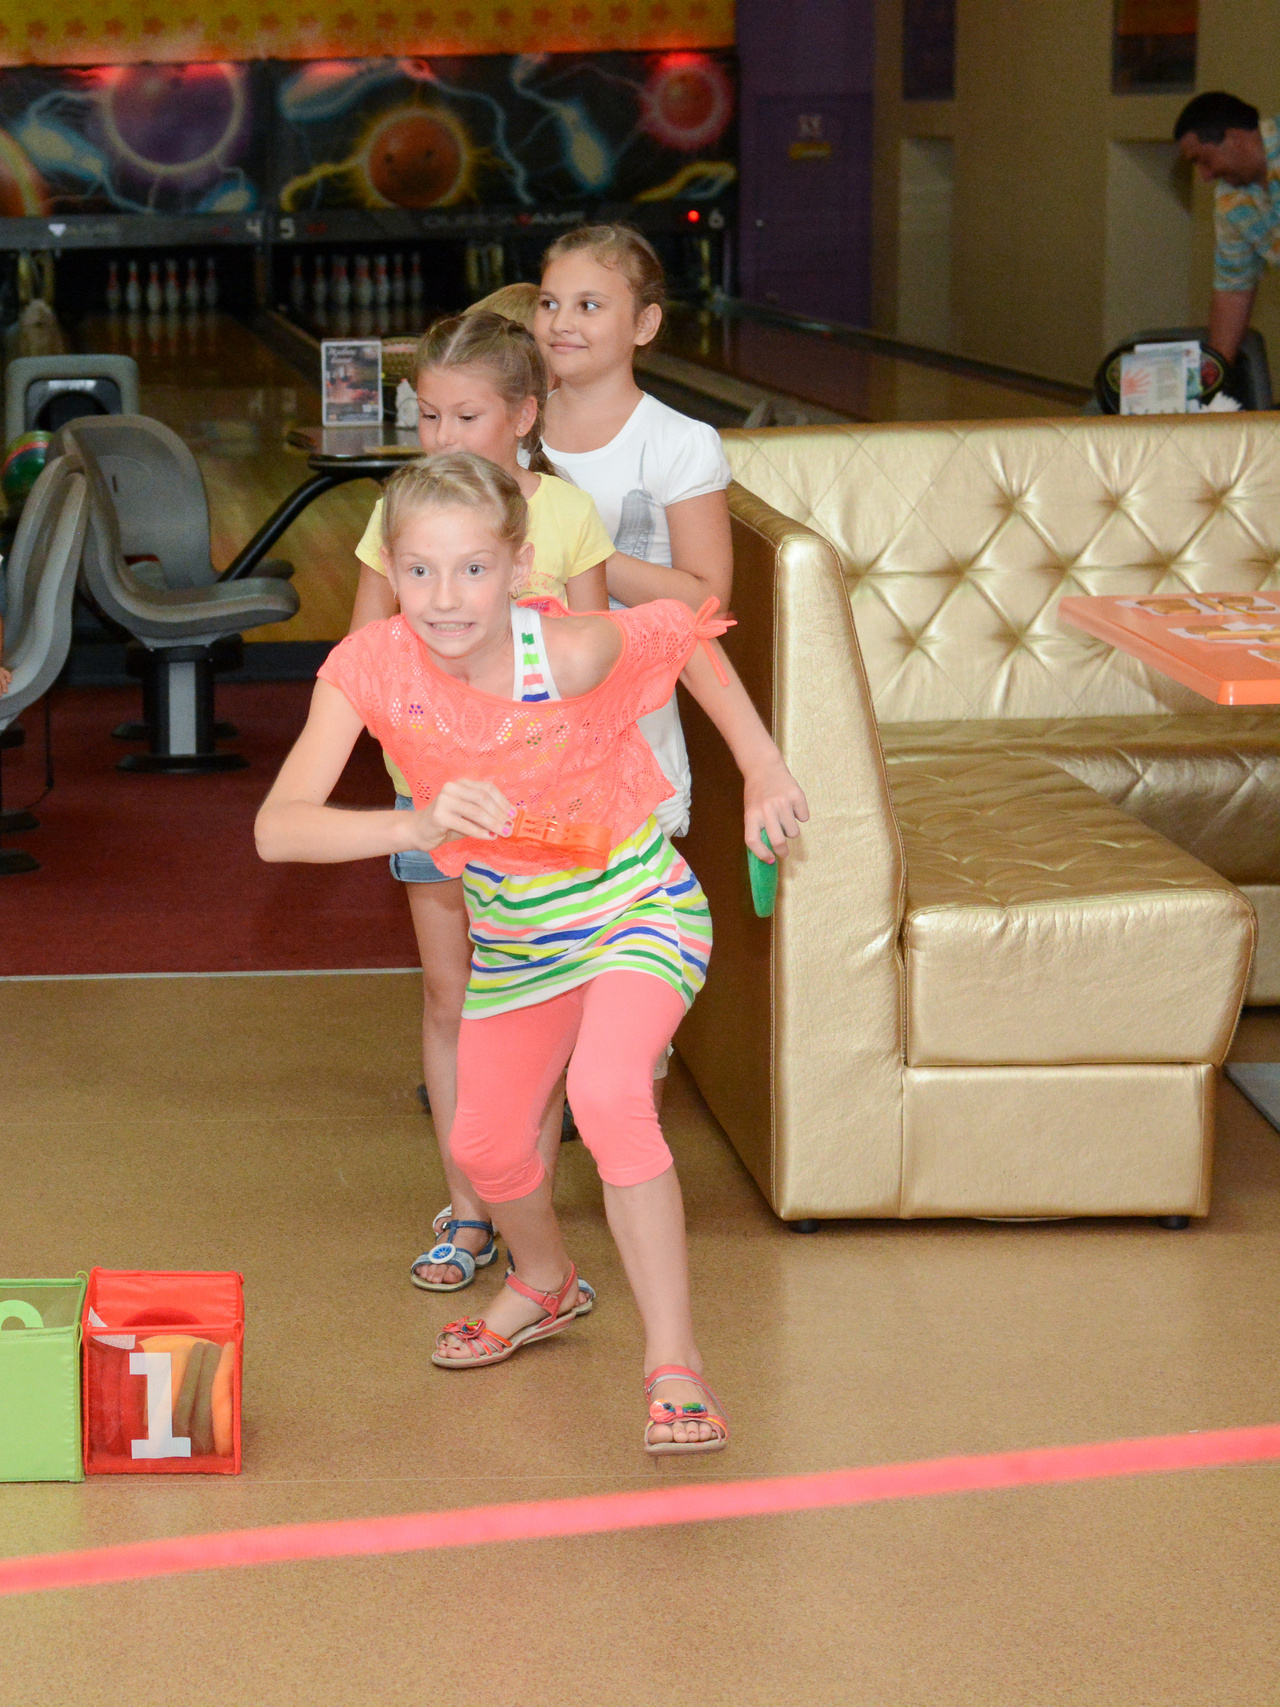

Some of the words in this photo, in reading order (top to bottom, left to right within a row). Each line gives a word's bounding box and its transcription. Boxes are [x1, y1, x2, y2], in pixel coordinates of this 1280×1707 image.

[245, 219, 263, 239] 4
[279, 218, 296, 239] 5
[129, 1353, 191, 1460] 1
